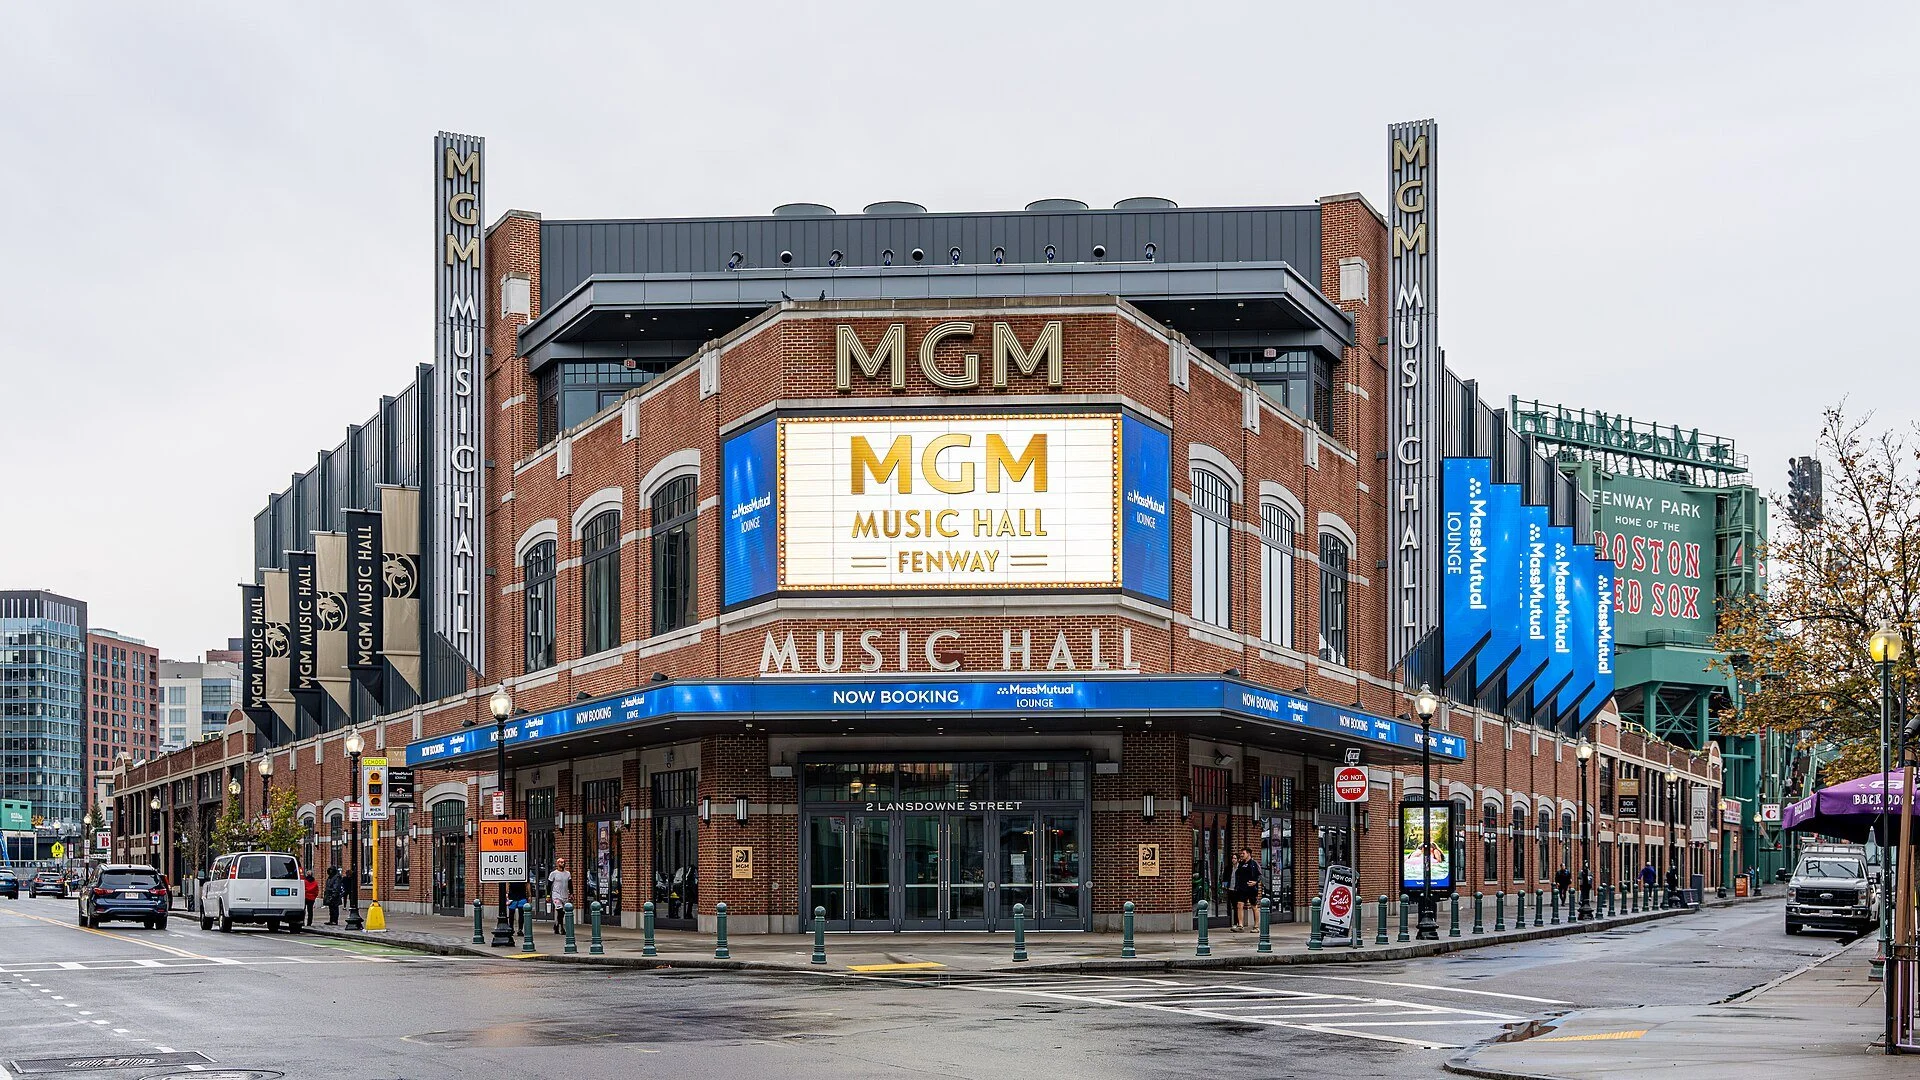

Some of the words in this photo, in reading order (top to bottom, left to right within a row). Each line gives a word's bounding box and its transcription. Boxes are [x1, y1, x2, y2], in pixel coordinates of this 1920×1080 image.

[445, 147, 480, 269] MGM
[1393, 134, 1427, 258] MGM
[836, 320, 1064, 392] MGM
[1396, 281, 1424, 465] MUSIC
[450, 292, 477, 472] MUSIC
[850, 434, 1048, 494] MGM
[738, 492, 770, 516] MassMutual
[1134, 490, 1166, 515] MassMutual
[1593, 491, 1653, 511] FENWAY
[1662, 500, 1700, 518] PARK
[851, 508, 960, 539] MUSIC
[973, 508, 1048, 536] HALL
[1615, 516, 1641, 527] HOME
[1646, 520, 1660, 529] OF
[1662, 522, 1680, 532] THE
[358, 526, 371, 560] HALL
[454, 490, 474, 632] HALL
[1400, 483, 1420, 628] HALL
[1447, 512, 1461, 574] LOUNGE
[1470, 500, 1486, 610] MassMutual
[298, 564, 311, 594] HALL
[898, 550, 1000, 573] FENWAY
[358, 566, 372, 617] MUSIC
[1530, 542, 1545, 640] MassMutual
[1555, 561, 1570, 654] MassMutual
[1614, 576, 1643, 614] ED
[1652, 582, 1700, 619] SOX
[252, 596, 262, 624] HALL
[299, 600, 312, 646] MUSIC
[252, 628, 263, 669] MUSIC
[358, 622, 372, 665] MGM
[759, 630, 962, 672] MUSIC
[1002, 628, 1141, 670] HALL
[1598, 592, 1612, 674] MassMutual
[300, 650, 312, 688] MGM
[252, 672, 263, 708] MGM
[833, 690, 875, 704] NOW
[880, 690, 959, 704] BOOKING
[1010, 684, 1073, 695] MassMutual
[1016, 699, 1053, 708] LOUNGE
[1242, 693, 1256, 707] NOW
[1256, 696, 1279, 712] BOOKING
[576, 711, 588, 724] NOW
[589, 706, 612, 721] BOOKING
[1340, 715, 1350, 728] NOW
[1351, 718, 1368, 731] BOOKING
[866, 803, 873, 811] 2
[878, 802, 965, 811] LANSDOWNE
[969, 801, 1022, 810] STREET
[1766, 810, 1776, 819] C
[1853, 794, 1881, 805] BACK
[102, 838, 109, 846] B
[483, 827, 498, 835] END
